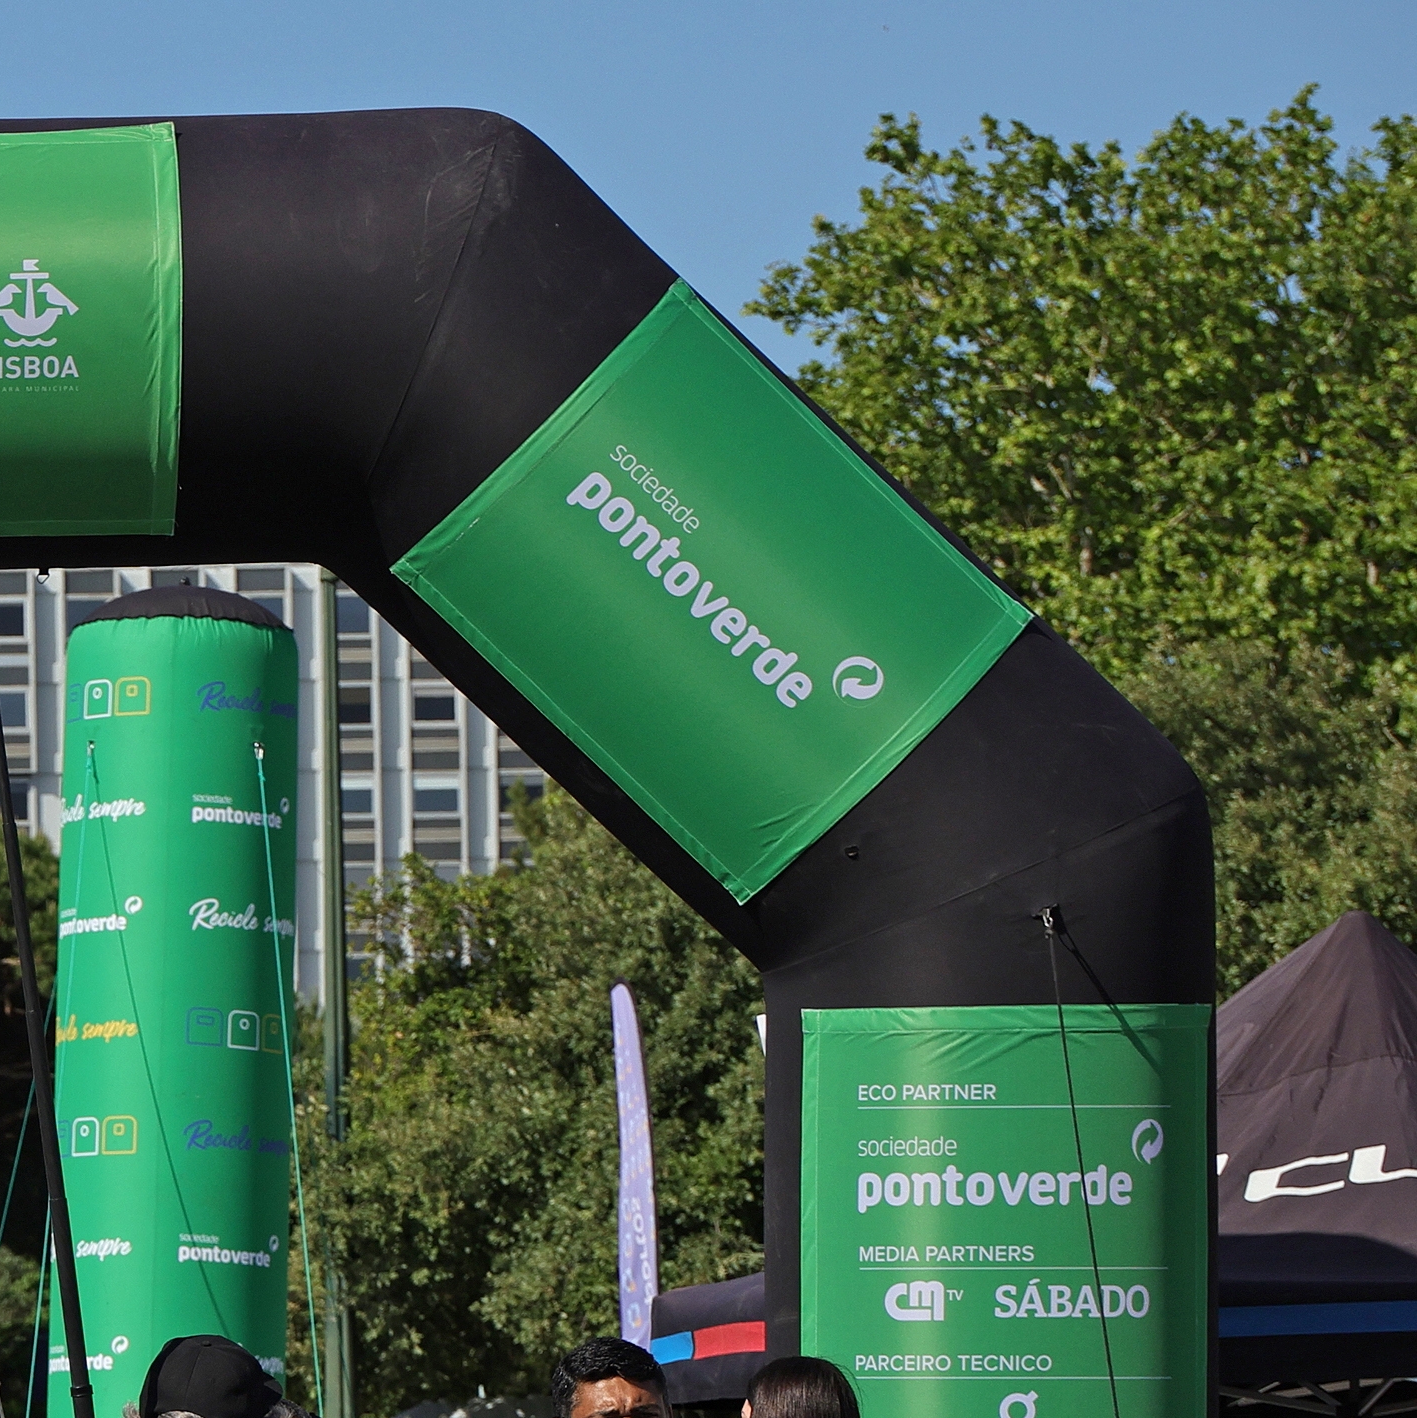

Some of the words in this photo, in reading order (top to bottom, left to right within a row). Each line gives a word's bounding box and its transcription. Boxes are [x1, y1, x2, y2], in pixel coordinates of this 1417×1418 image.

[609, 444, 700, 533] sociedade
[566, 472, 813, 708] pontoverde
[191, 807, 282, 828] pontoverde
[189, 898, 258, 931] Recicle
[858, 1084, 896, 1101] ECO
[902, 1084, 996, 1100] PARTNER
[858, 1136, 957, 1157] sociedade
[857, 1165, 1132, 1213] pontoverde
[76, 1238, 132, 1262] sempre
[178, 1245, 271, 1268] pontoverde
[859, 1246, 919, 1262] MEDIA
[925, 1246, 1034, 1261] PARTNERS
[994, 1279, 1150, 1318] SÁBADO
[855, 1355, 950, 1372] PARCEIRO
[958, 1355, 1052, 1371] TECNICO
